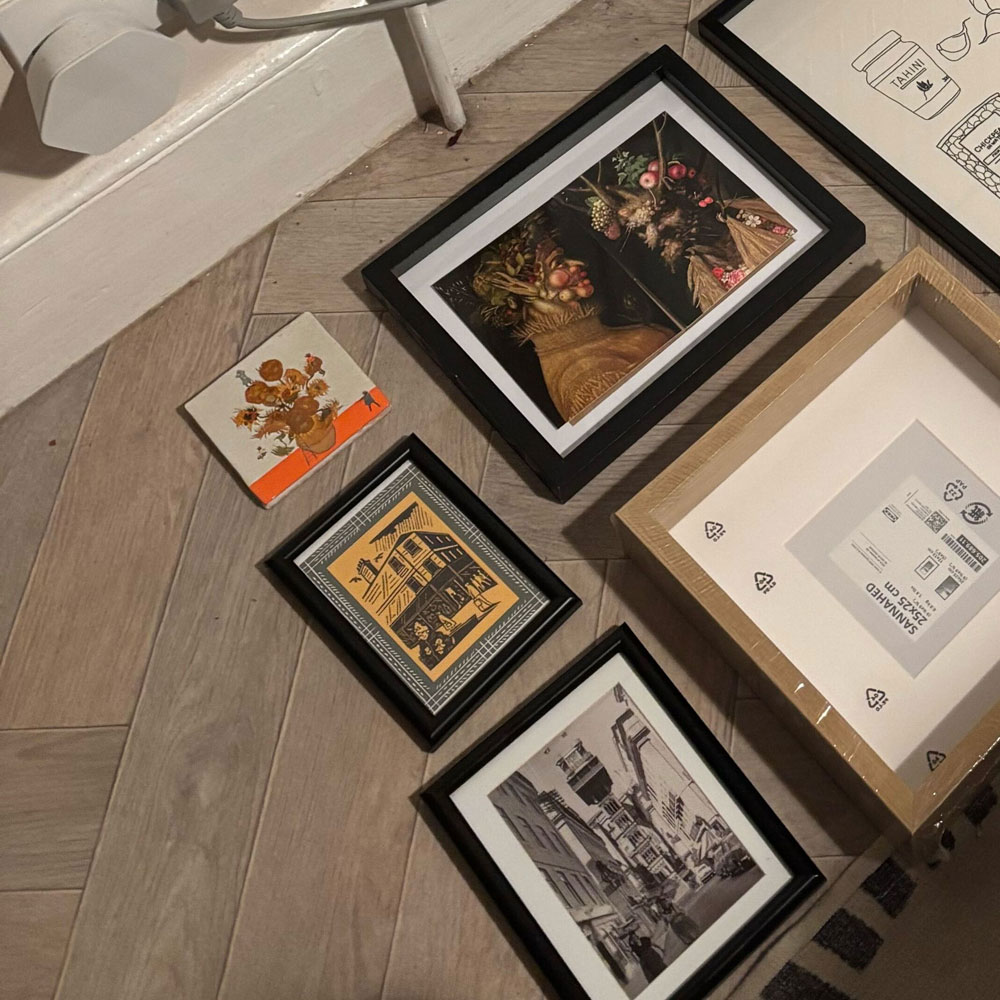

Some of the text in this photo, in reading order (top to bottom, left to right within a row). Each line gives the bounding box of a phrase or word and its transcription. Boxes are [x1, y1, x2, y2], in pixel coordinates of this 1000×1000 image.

[889, 58, 925, 88] TAHINI
[956, 479, 968, 490] PAP
[865, 582, 918, 635] SANNAHED
[884, 581, 928, 626] 25x25 cm
